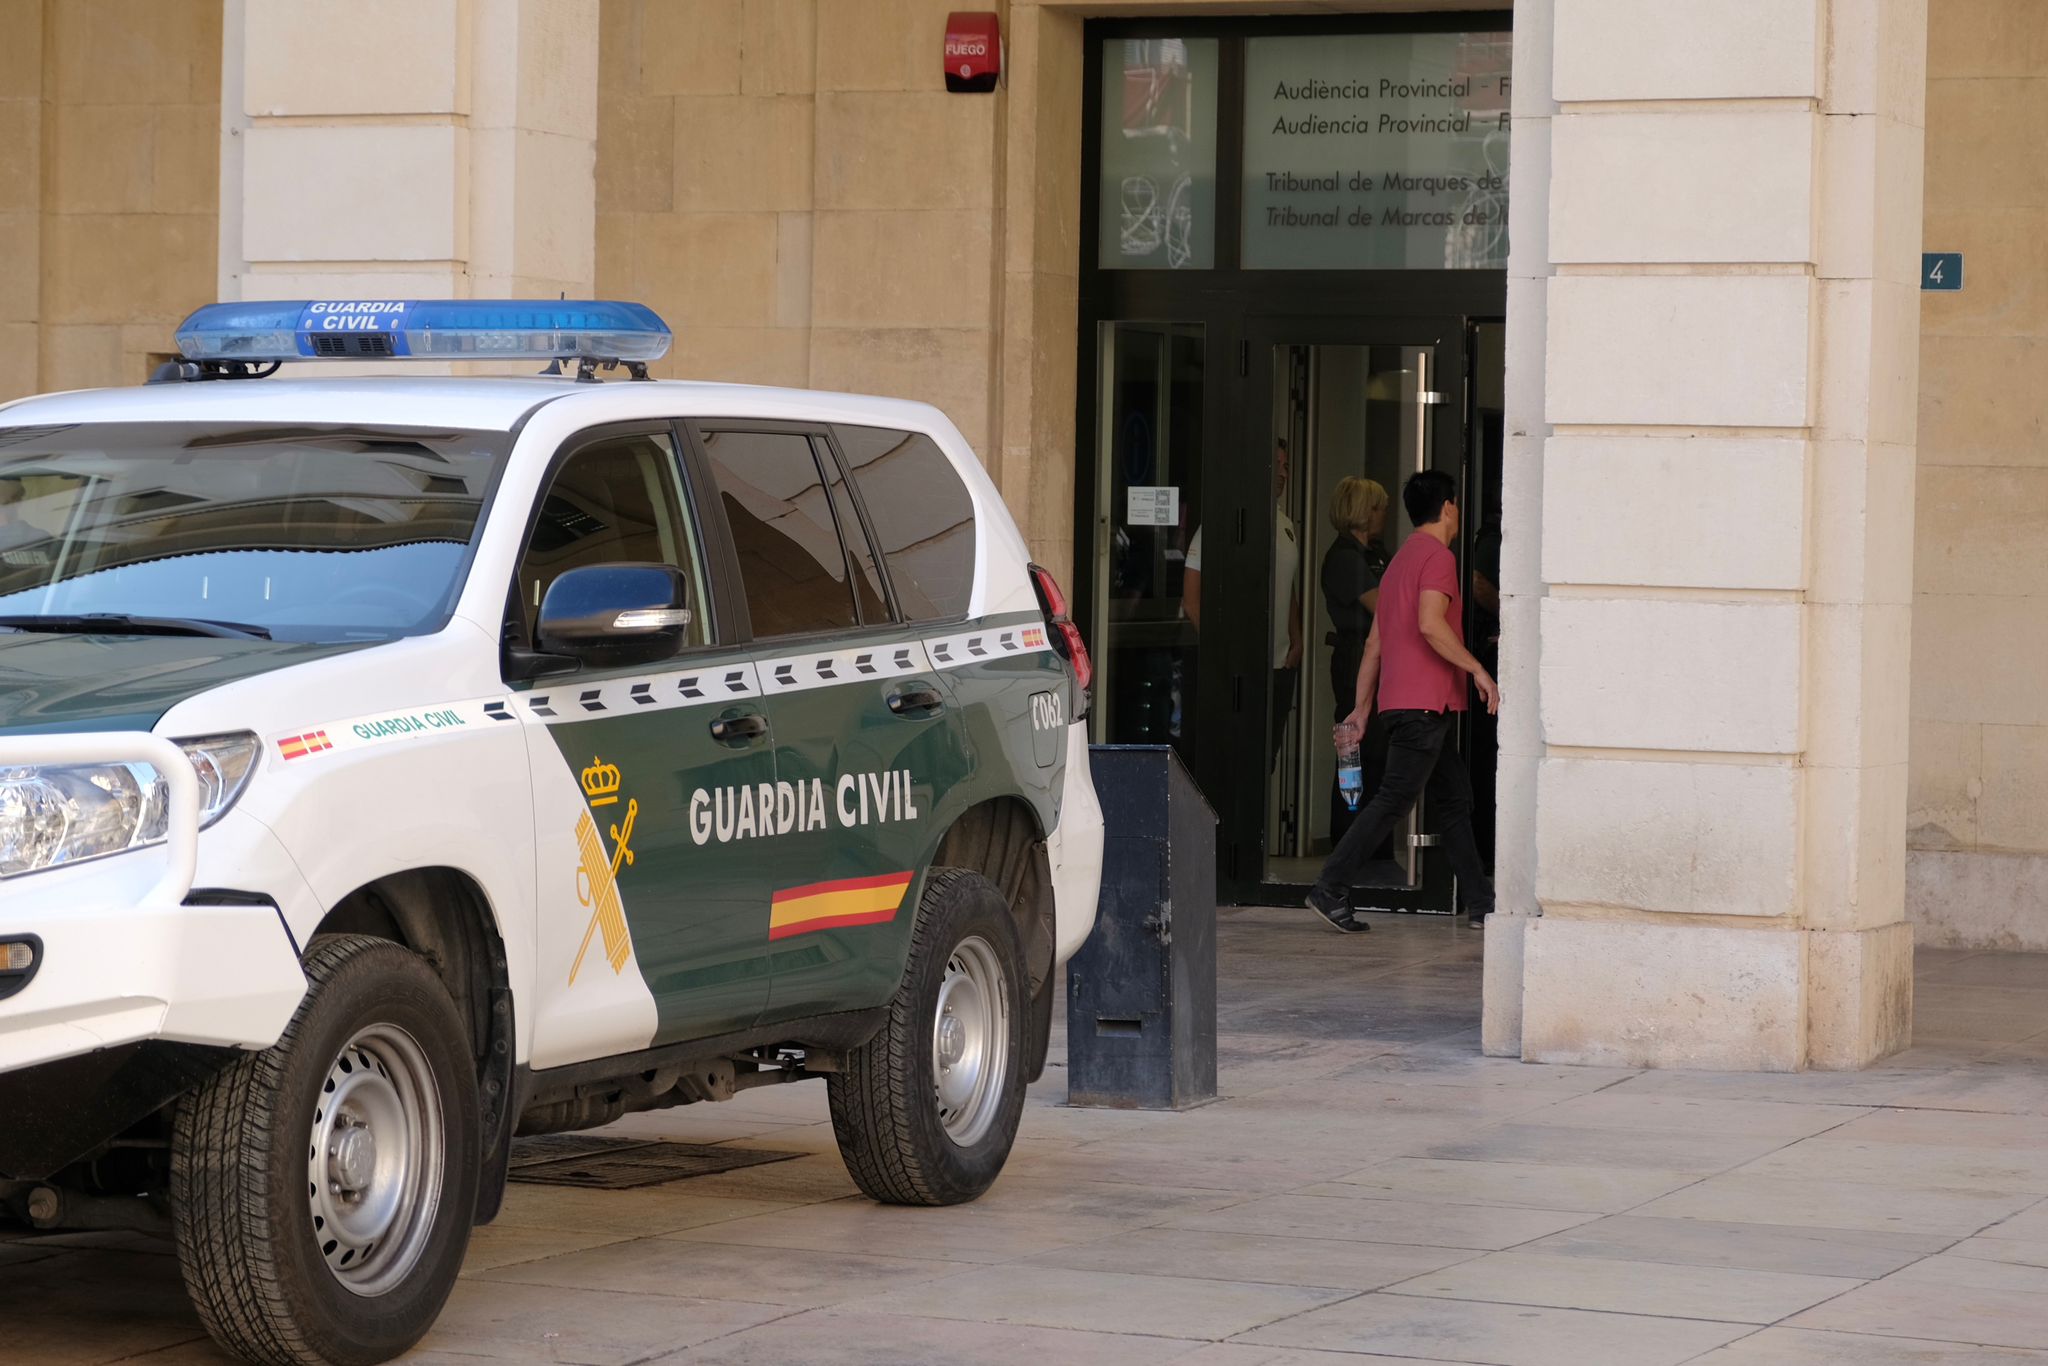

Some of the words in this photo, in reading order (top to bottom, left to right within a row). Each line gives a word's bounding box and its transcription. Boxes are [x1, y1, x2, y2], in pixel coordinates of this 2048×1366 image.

[945, 44, 986, 56] FUEGO
[1273, 78, 1370, 100] Audiència
[1379, 76, 1470, 98] Provincial
[1272, 113, 1370, 135] Audiencia
[1378, 111, 1471, 133] Provincial
[1265, 170, 1340, 192] Tribunal
[1348, 170, 1373, 192] de
[1382, 170, 1469, 196] Marques
[1477, 169, 1502, 191] de
[1265, 205, 1340, 227] Tribunal
[1347, 205, 1373, 227] de
[1381, 206, 1456, 227] Marcas
[1462, 204, 1489, 226] de
[1929, 259, 1944, 284] 4
[310, 302, 405, 314] GUARDIA
[322, 315, 379, 330] CIVIL
[1039, 692, 1064, 730] 062
[353, 715, 428, 740] GUARDIA
[424, 709, 466, 728] CIVIL
[689, 777, 827, 846] GUARDIA
[836, 769, 918, 828] CIVIL
